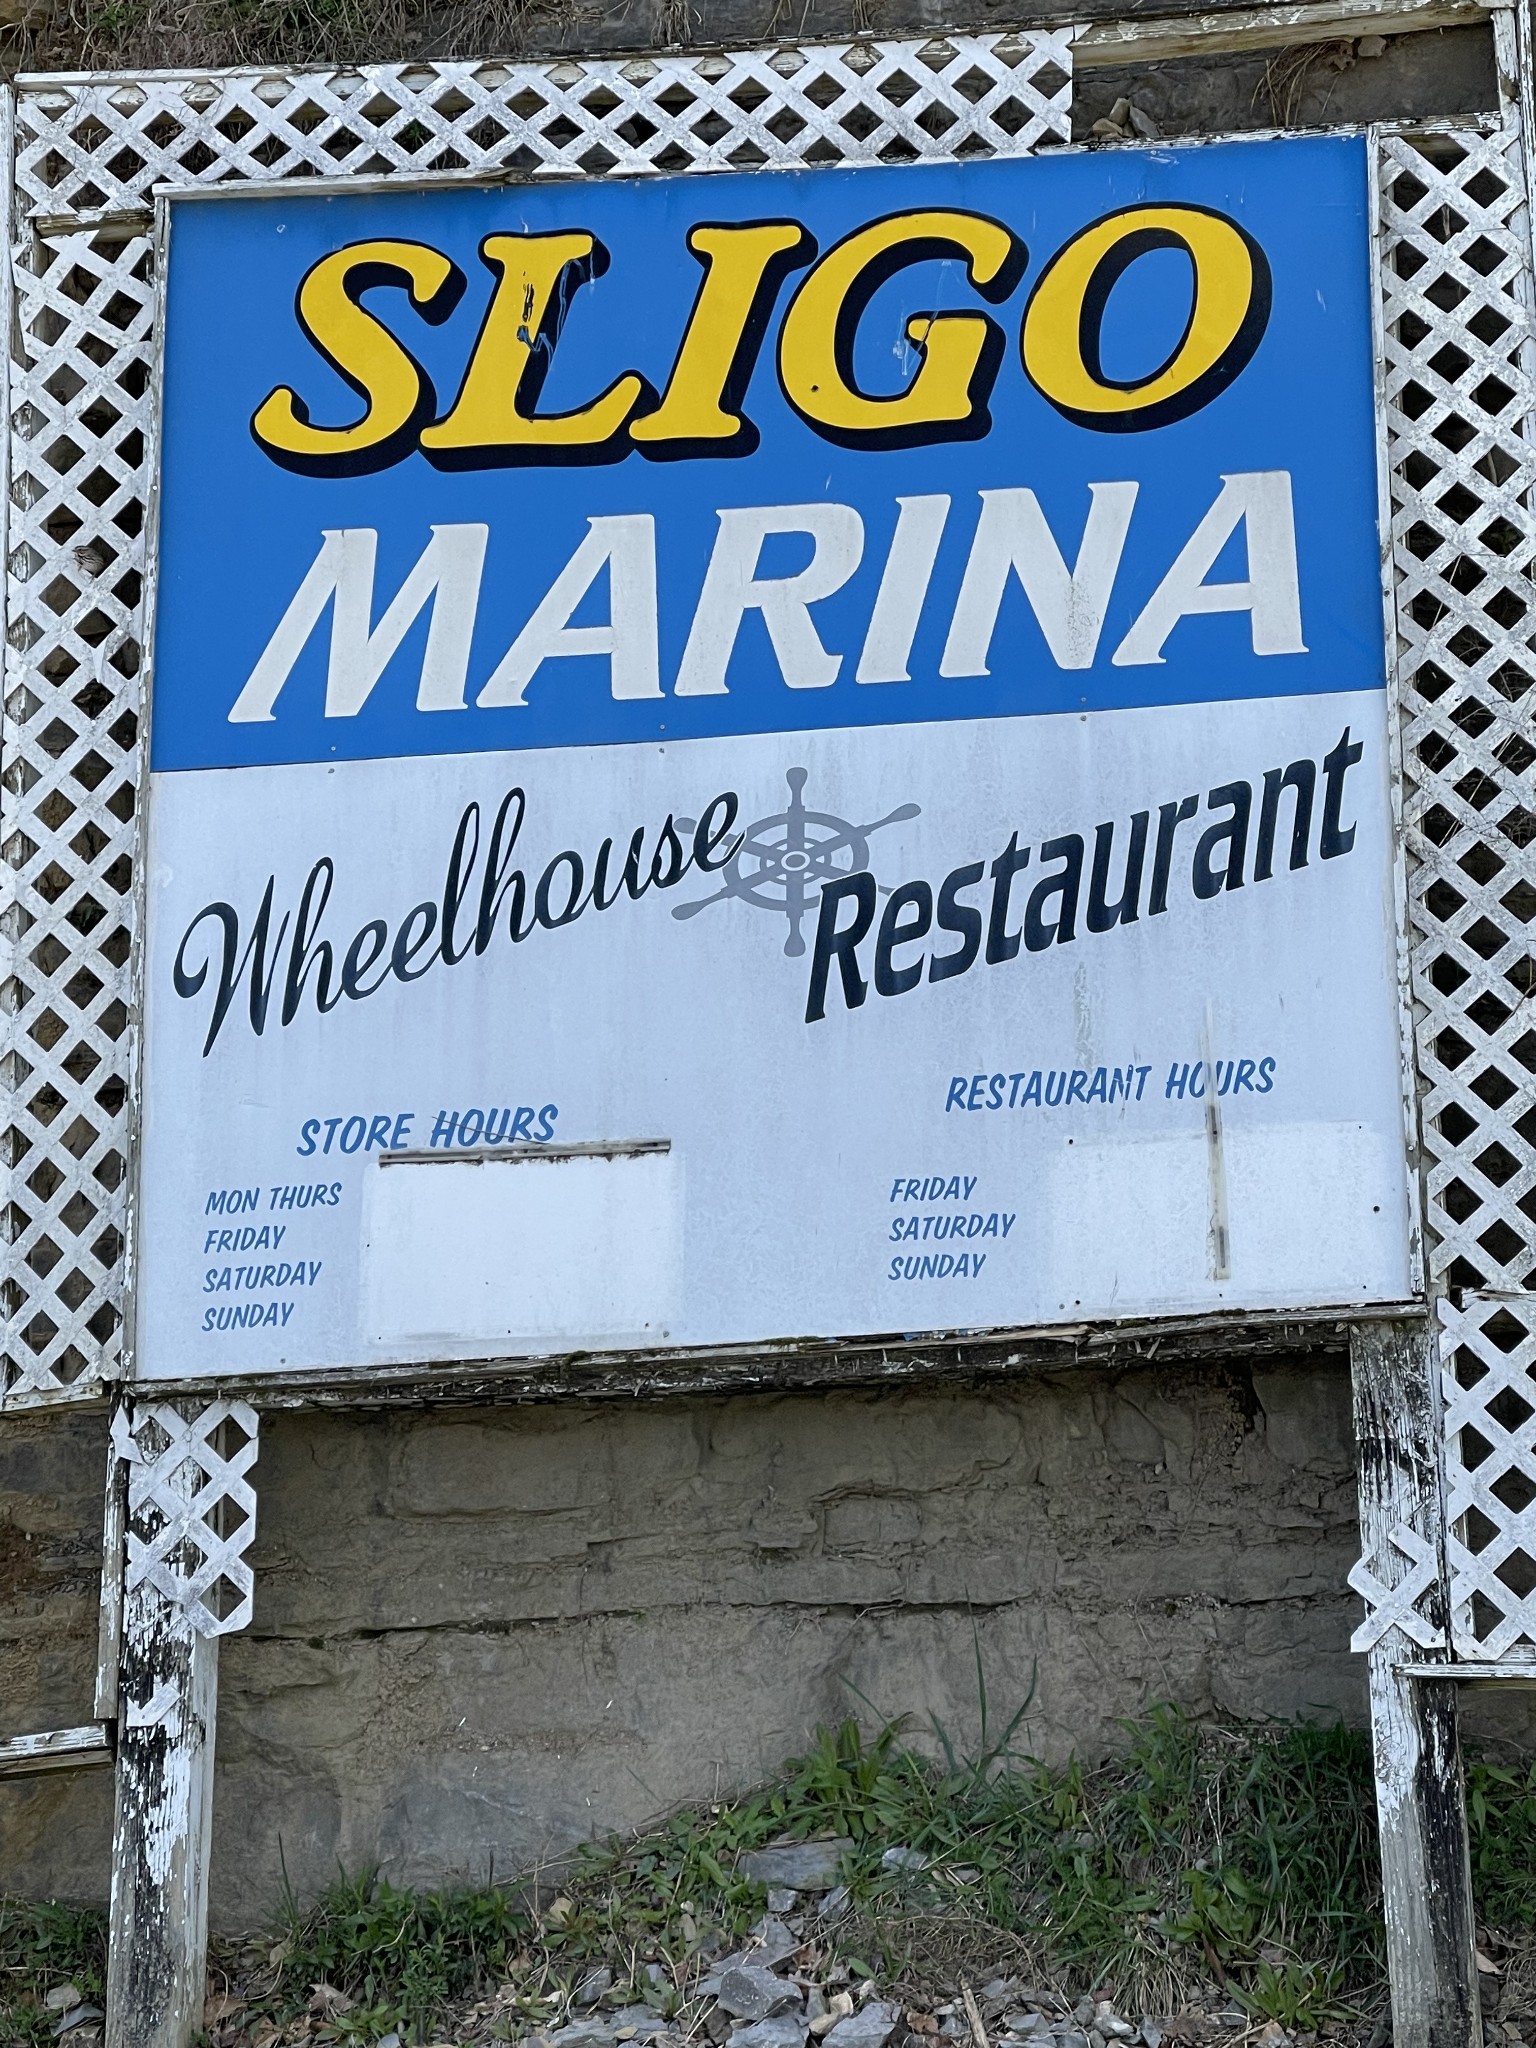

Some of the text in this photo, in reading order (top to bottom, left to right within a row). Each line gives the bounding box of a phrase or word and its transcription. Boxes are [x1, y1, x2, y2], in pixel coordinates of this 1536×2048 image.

[250, 201, 1273, 480] SLIGO
[228, 470, 1309, 723] MARINA
[173, 725, 1364, 1058] Wheelhouse Restaurant
[945, 1056, 1277, 1113] RESTAURANT HOURS
[296, 1103, 559, 1157] STORE HOURS
[204, 1182, 343, 1216] MON THURS
[890, 1175, 978, 1203] FRIDAY
[204, 1225, 286, 1254] FRIDAY
[888, 1213, 1016, 1242] SATURDAY
[202, 1261, 323, 1293] SATURDAY
[888, 1253, 987, 1281] SUNDAY
[201, 1302, 295, 1332] SUNDAY
